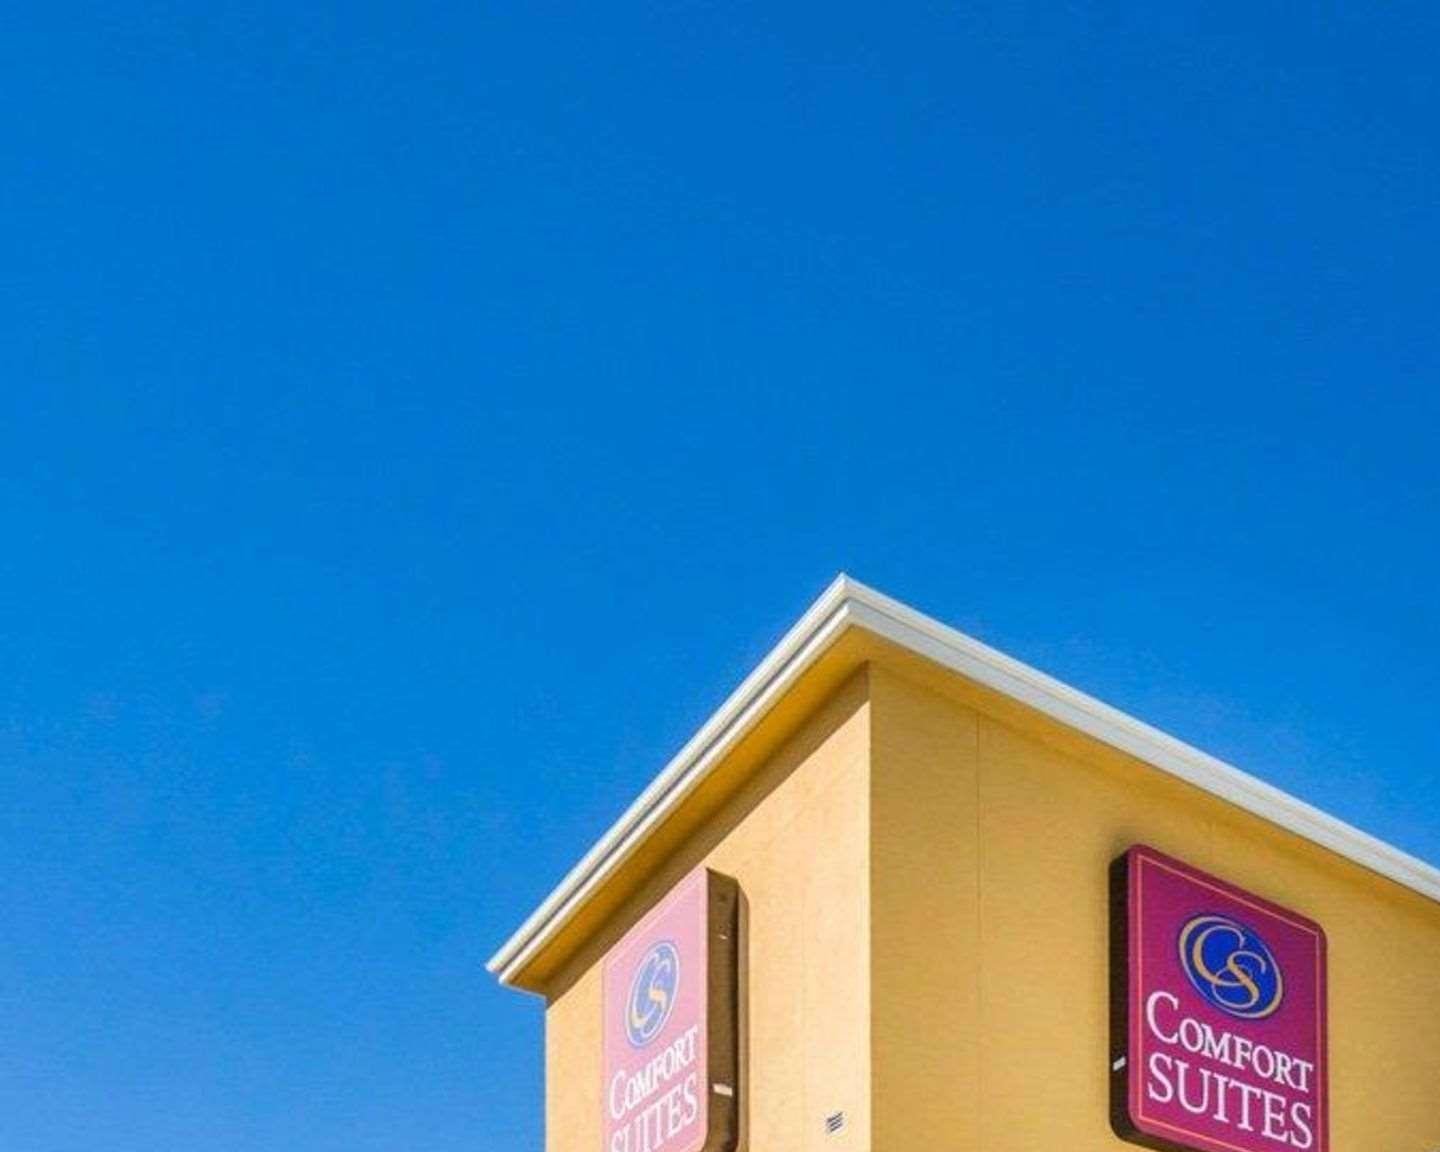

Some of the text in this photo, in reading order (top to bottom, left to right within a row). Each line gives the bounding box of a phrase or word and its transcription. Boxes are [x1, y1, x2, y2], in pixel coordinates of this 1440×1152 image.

[608, 1024, 699, 1121] COMFORT
[1146, 991, 1313, 1093] COMFORT
[1148, 1052, 1313, 1149] SUITES
